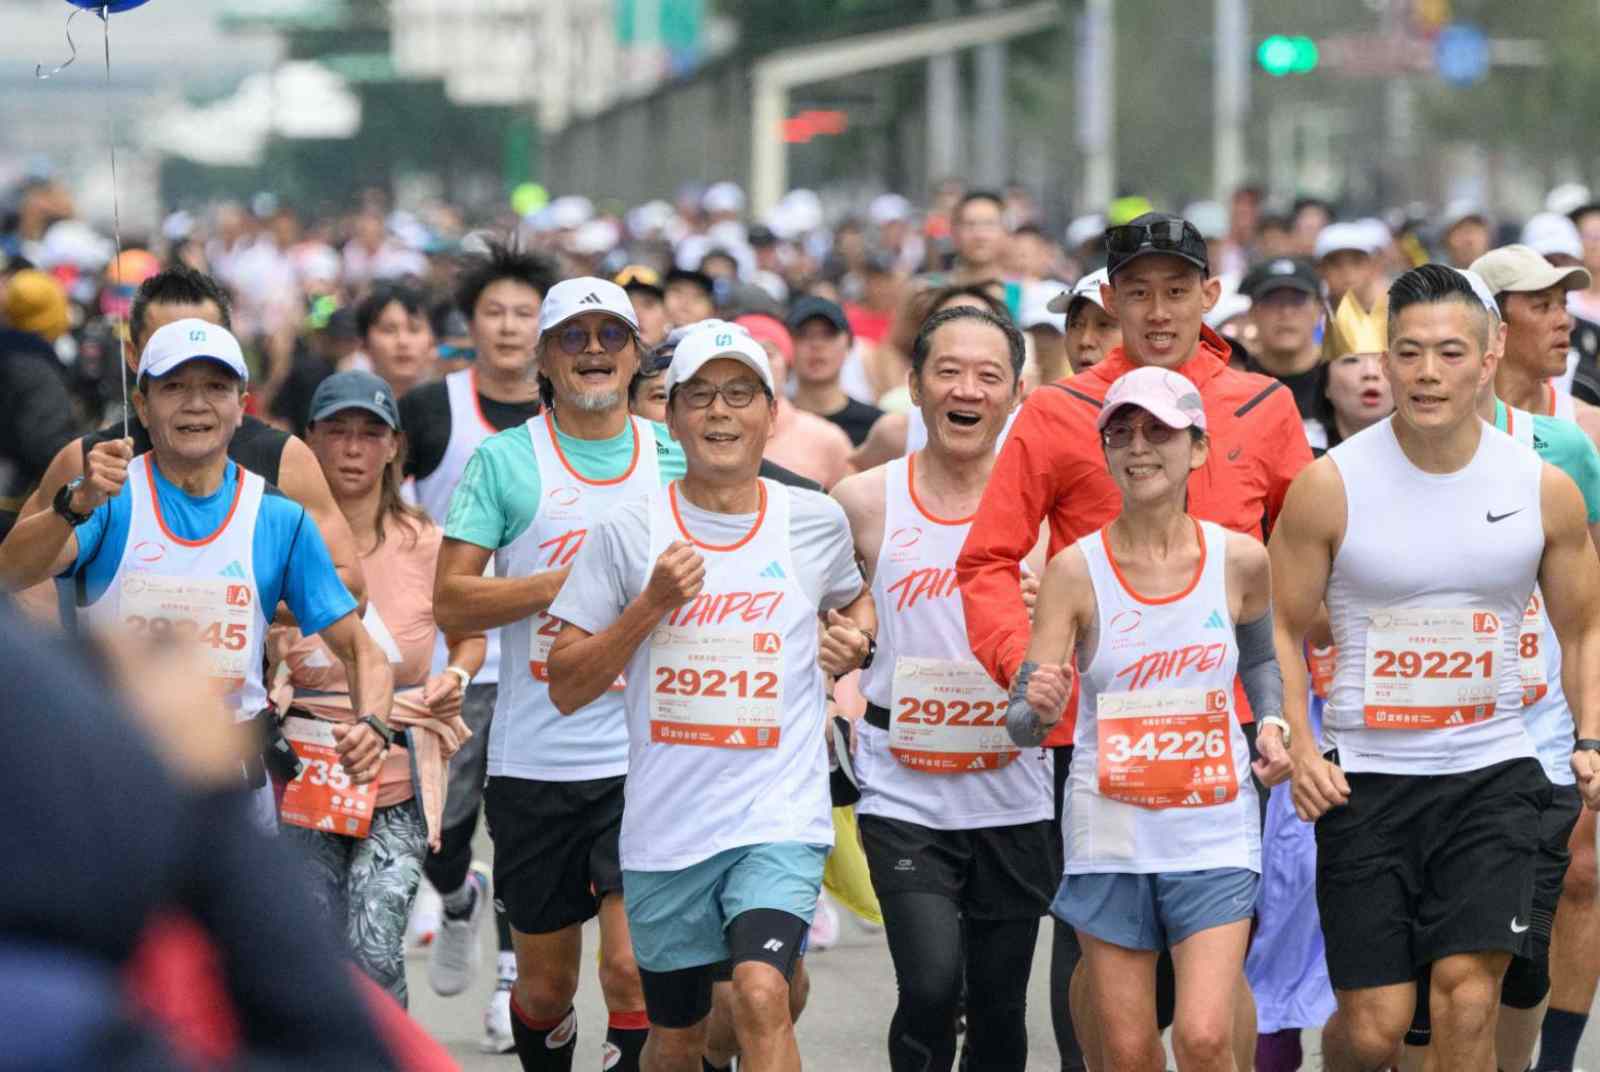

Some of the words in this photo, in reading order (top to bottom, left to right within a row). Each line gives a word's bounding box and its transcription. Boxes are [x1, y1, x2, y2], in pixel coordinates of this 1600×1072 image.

[1116, 642, 1228, 692] TAIPEI
[1372, 650, 1494, 679] 29221
[655, 665, 779, 699] 29212
[1105, 728, 1226, 763] 34226
